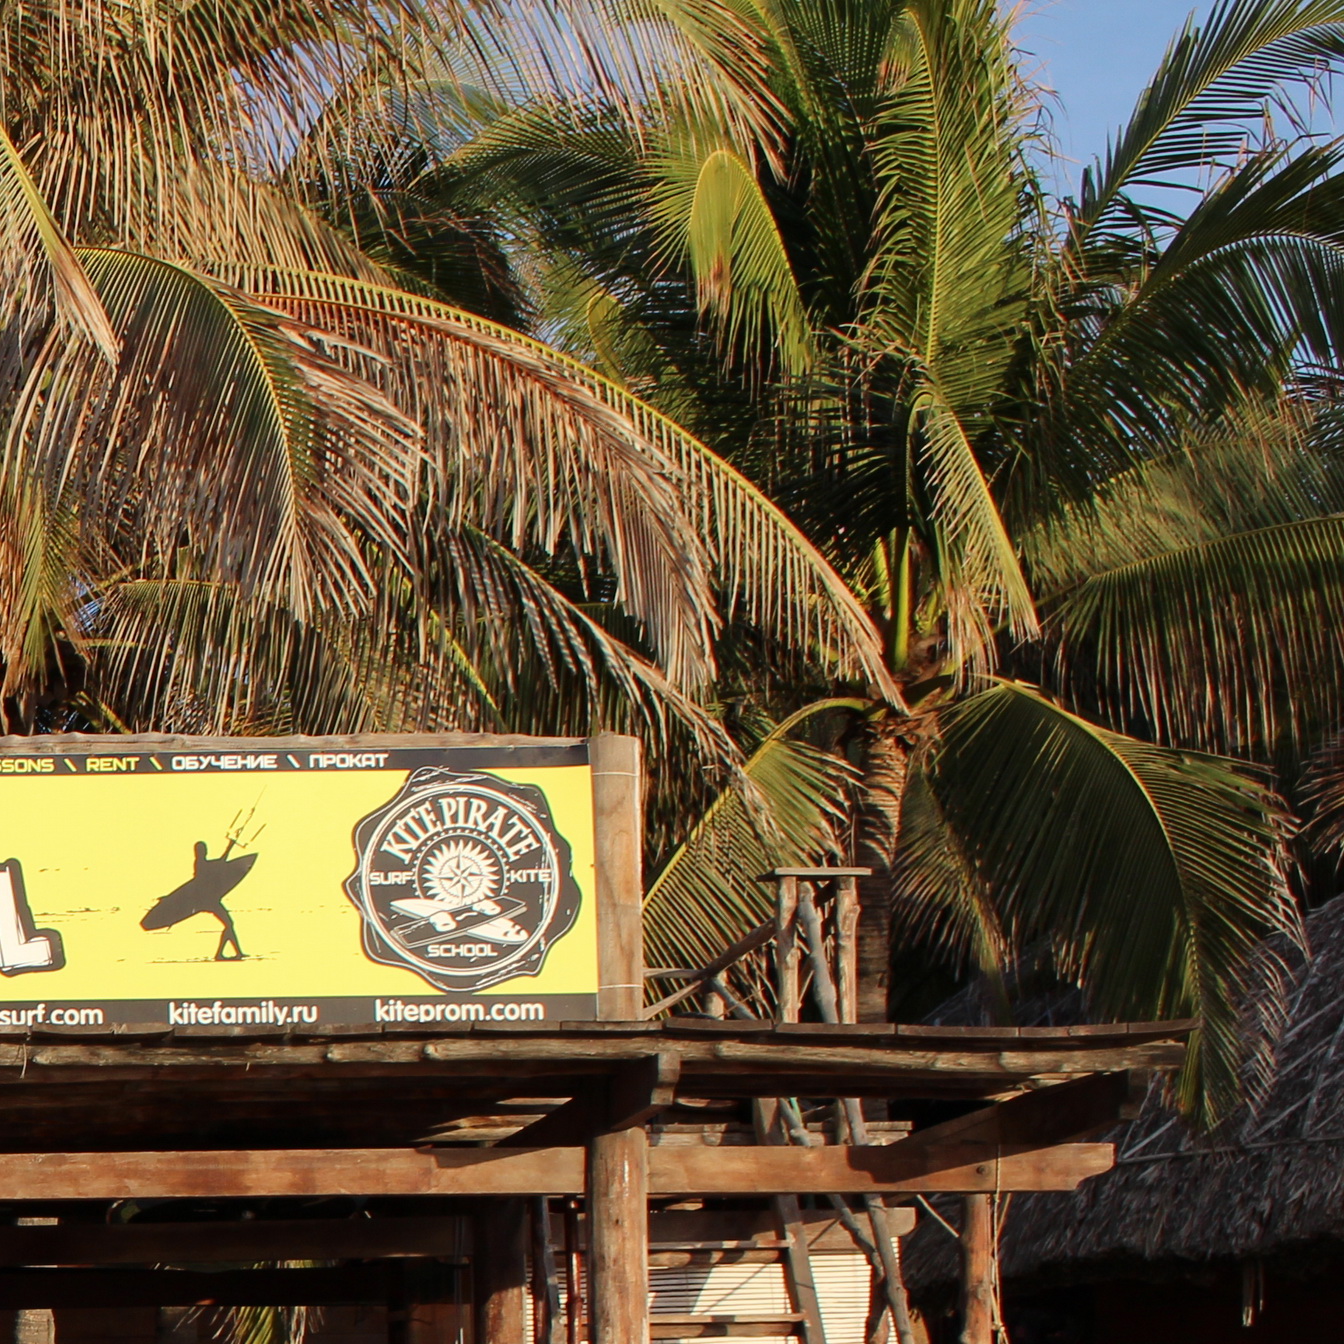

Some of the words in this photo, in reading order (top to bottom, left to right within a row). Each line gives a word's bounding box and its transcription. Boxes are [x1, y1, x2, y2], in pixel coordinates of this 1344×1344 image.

[86, 757, 139, 772] RENT
[172, 755, 277, 771] ОБУЧЕНИЕ
[309, 753, 389, 768] ПРОКАТ
[380, 801, 442, 865] KITE
[438, 796, 541, 862] PIRATE
[369, 871, 414, 886] SURF
[510, 869, 552, 883] KITE
[427, 944, 498, 958] SCHOOL
[168, 1001, 319, 1026] kitefamily.ru
[374, 999, 545, 1022] kiteprom.com
